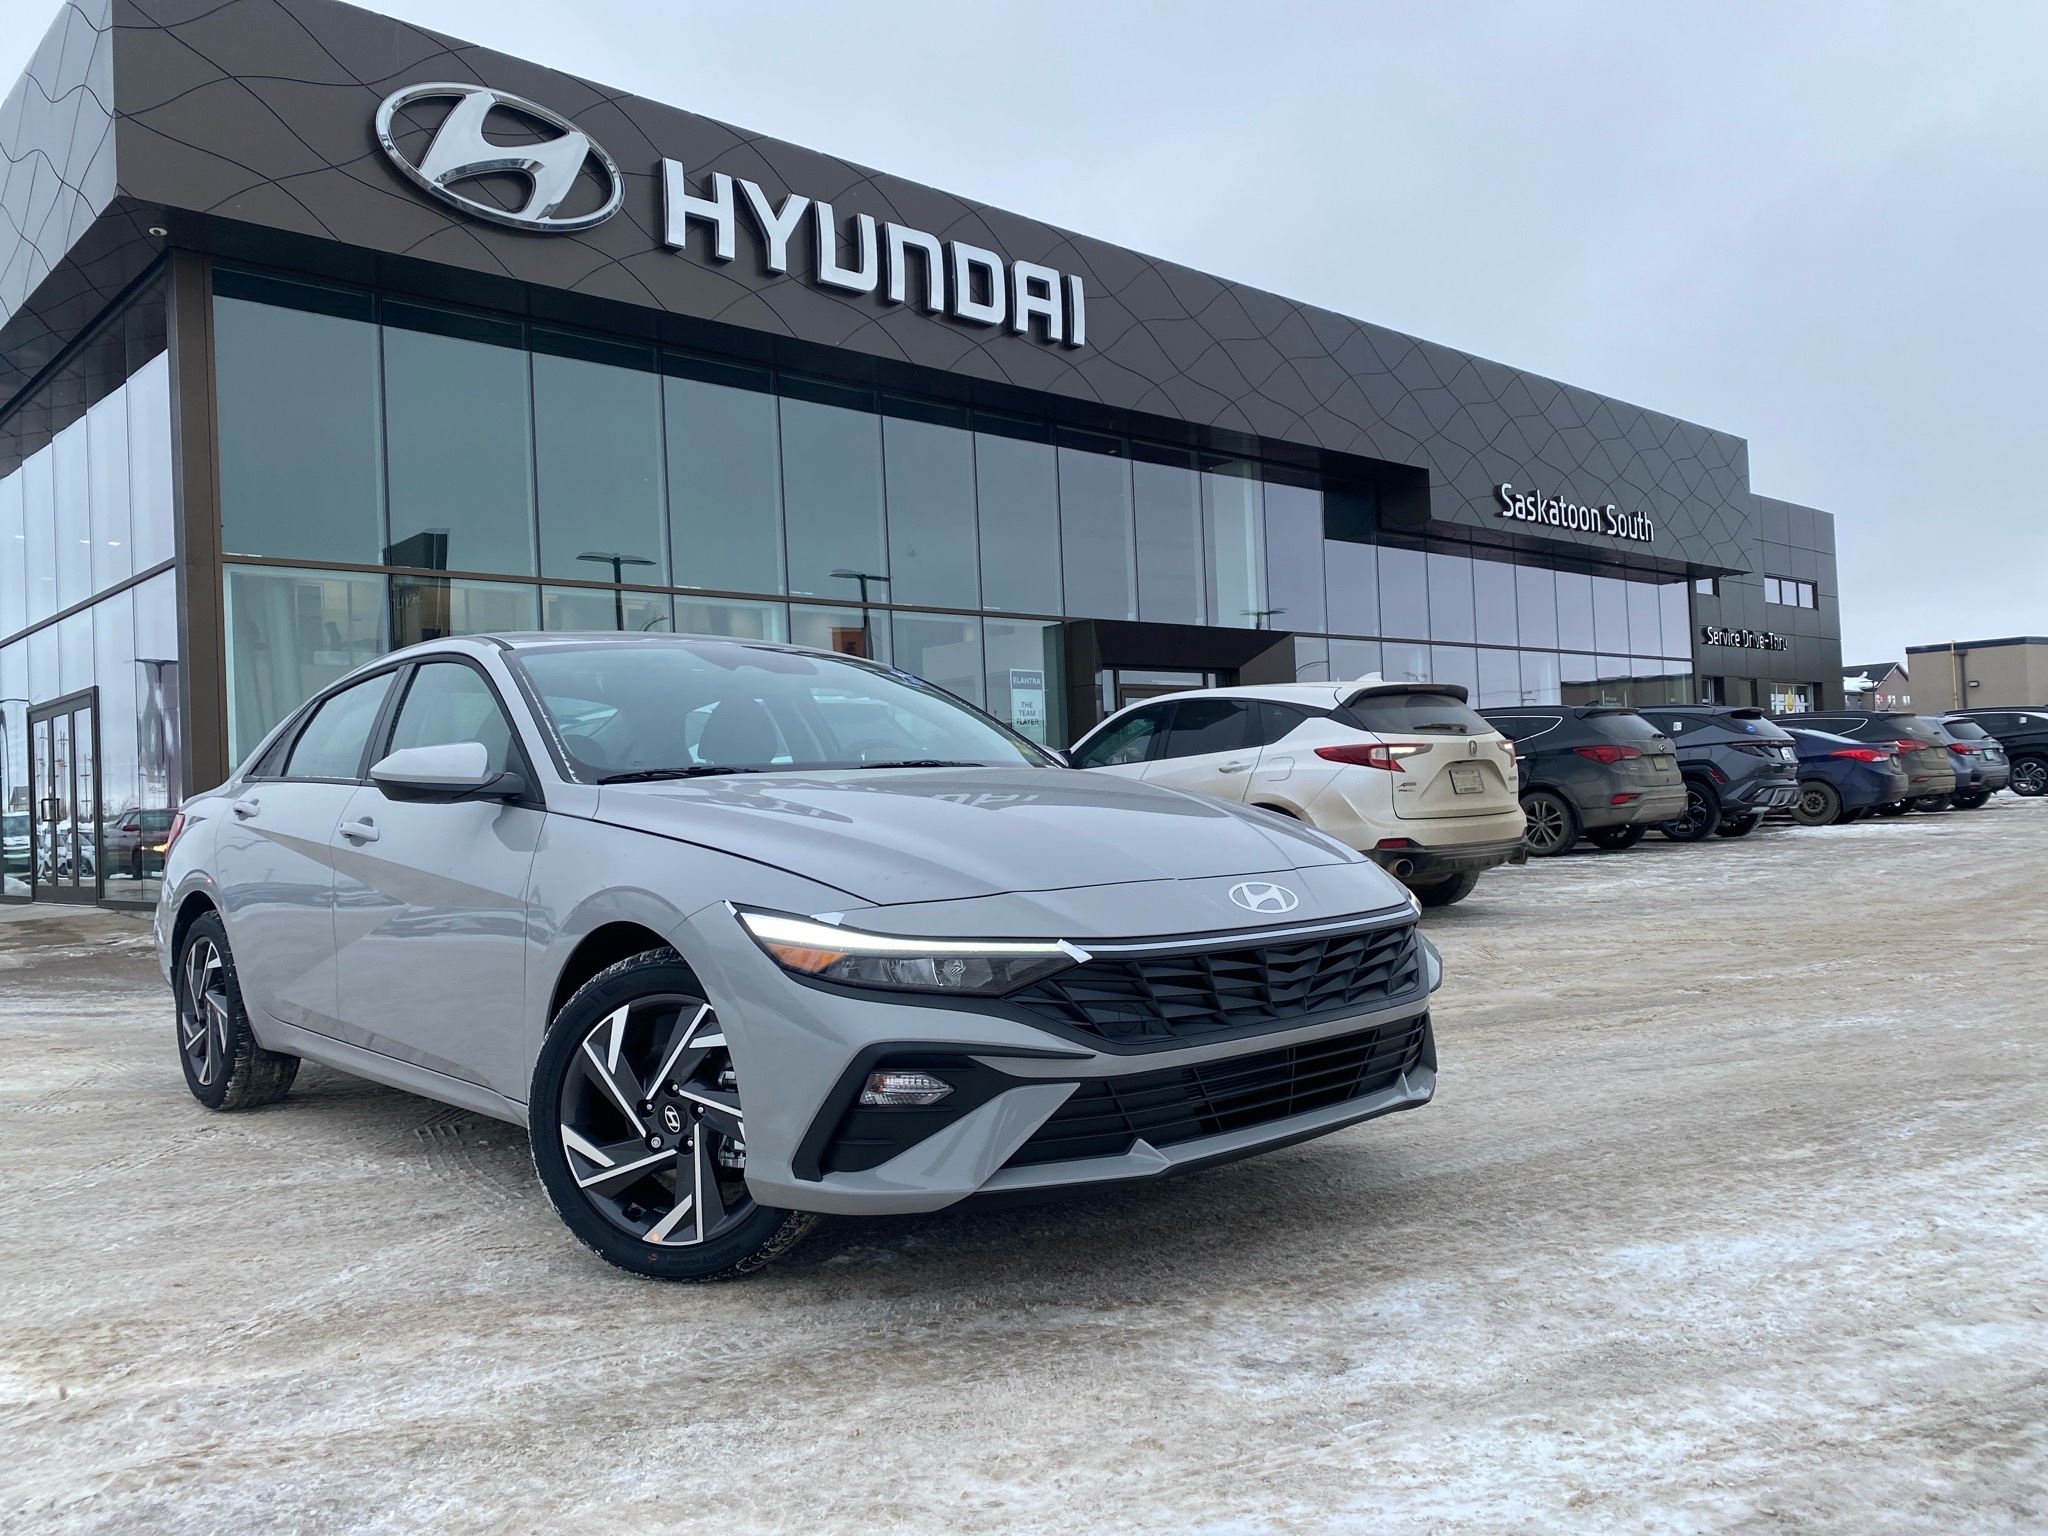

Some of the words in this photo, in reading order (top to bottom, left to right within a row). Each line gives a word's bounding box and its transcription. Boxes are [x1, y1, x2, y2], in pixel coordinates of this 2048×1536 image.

[662, 157, 1086, 347] HYUNDAI
[1501, 482, 1601, 532] Saskatoon
[1606, 504, 1654, 542] South
[1706, 626, 1741, 647] Service
[1742, 629, 1788, 651] Drive-Thru
[1013, 676, 1041, 685] ELANTRA
[1019, 709, 1036, 717] TEAM
[1021, 701, 1033, 709] THE
